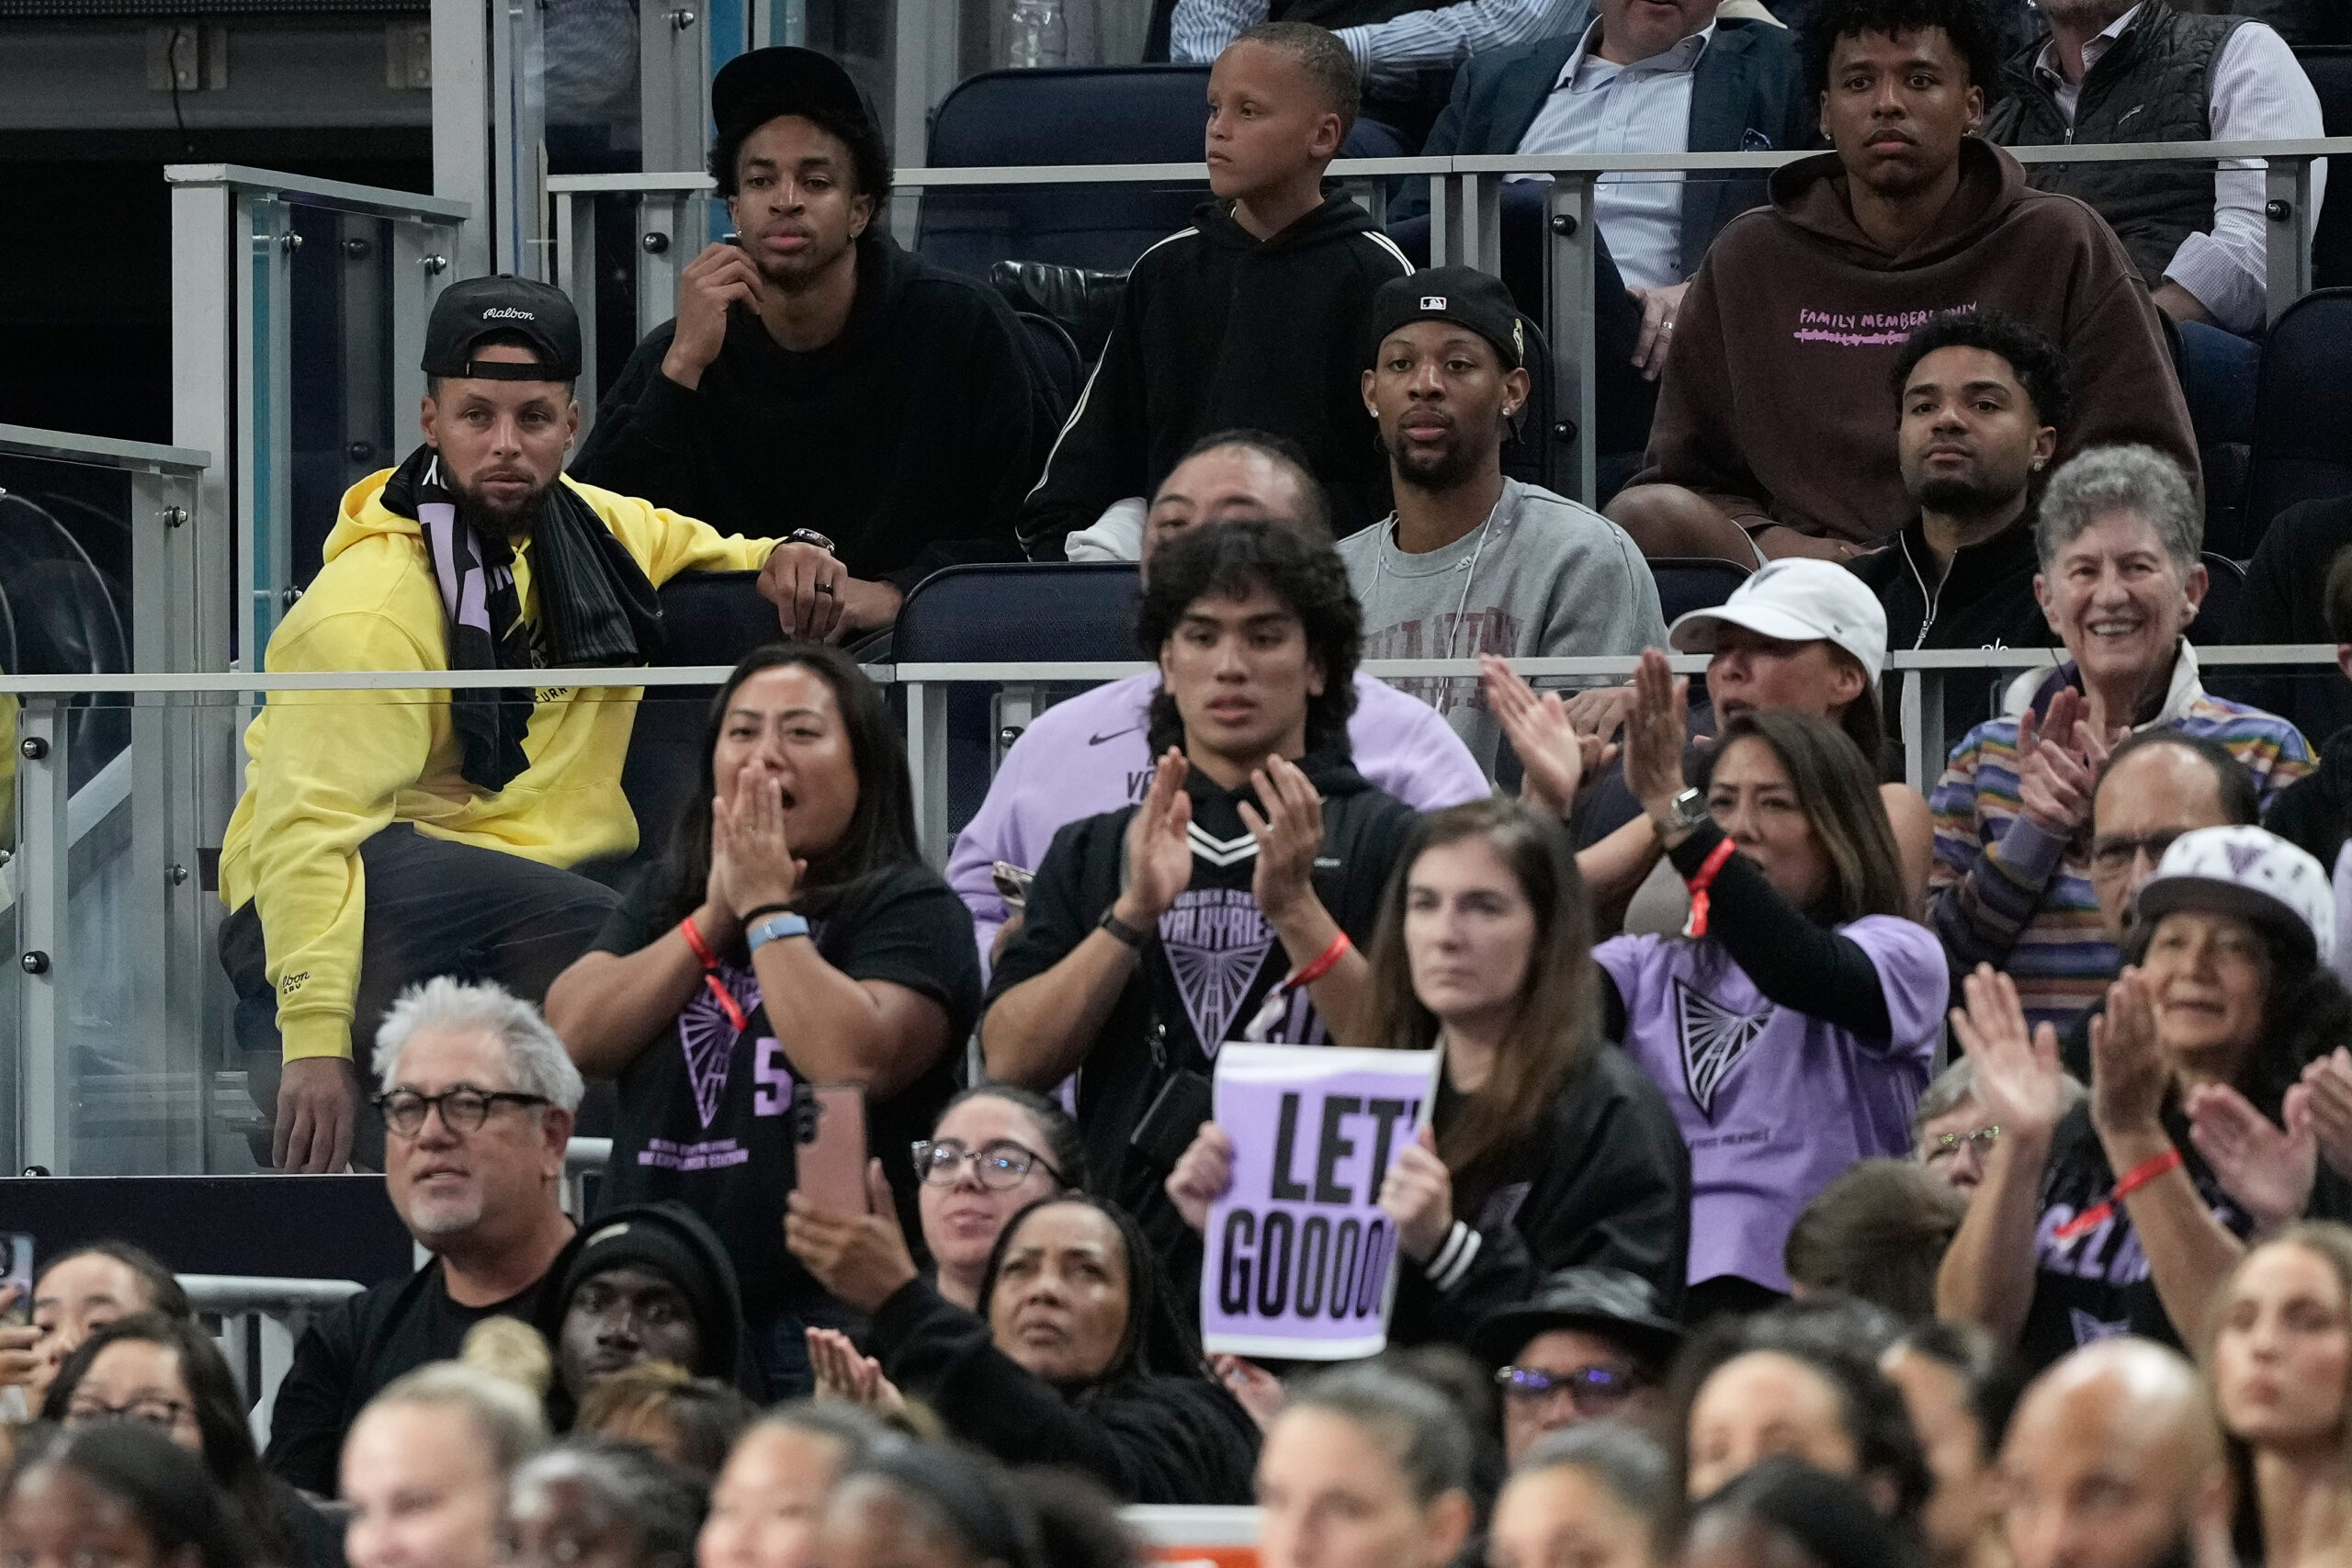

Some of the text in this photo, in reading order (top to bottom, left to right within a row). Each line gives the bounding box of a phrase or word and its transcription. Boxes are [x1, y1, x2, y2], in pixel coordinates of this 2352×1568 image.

[482, 307, 536, 321] Malbon
[1800, 308, 1856, 329] FAMILY
[753, 1036, 794, 1118] 5
